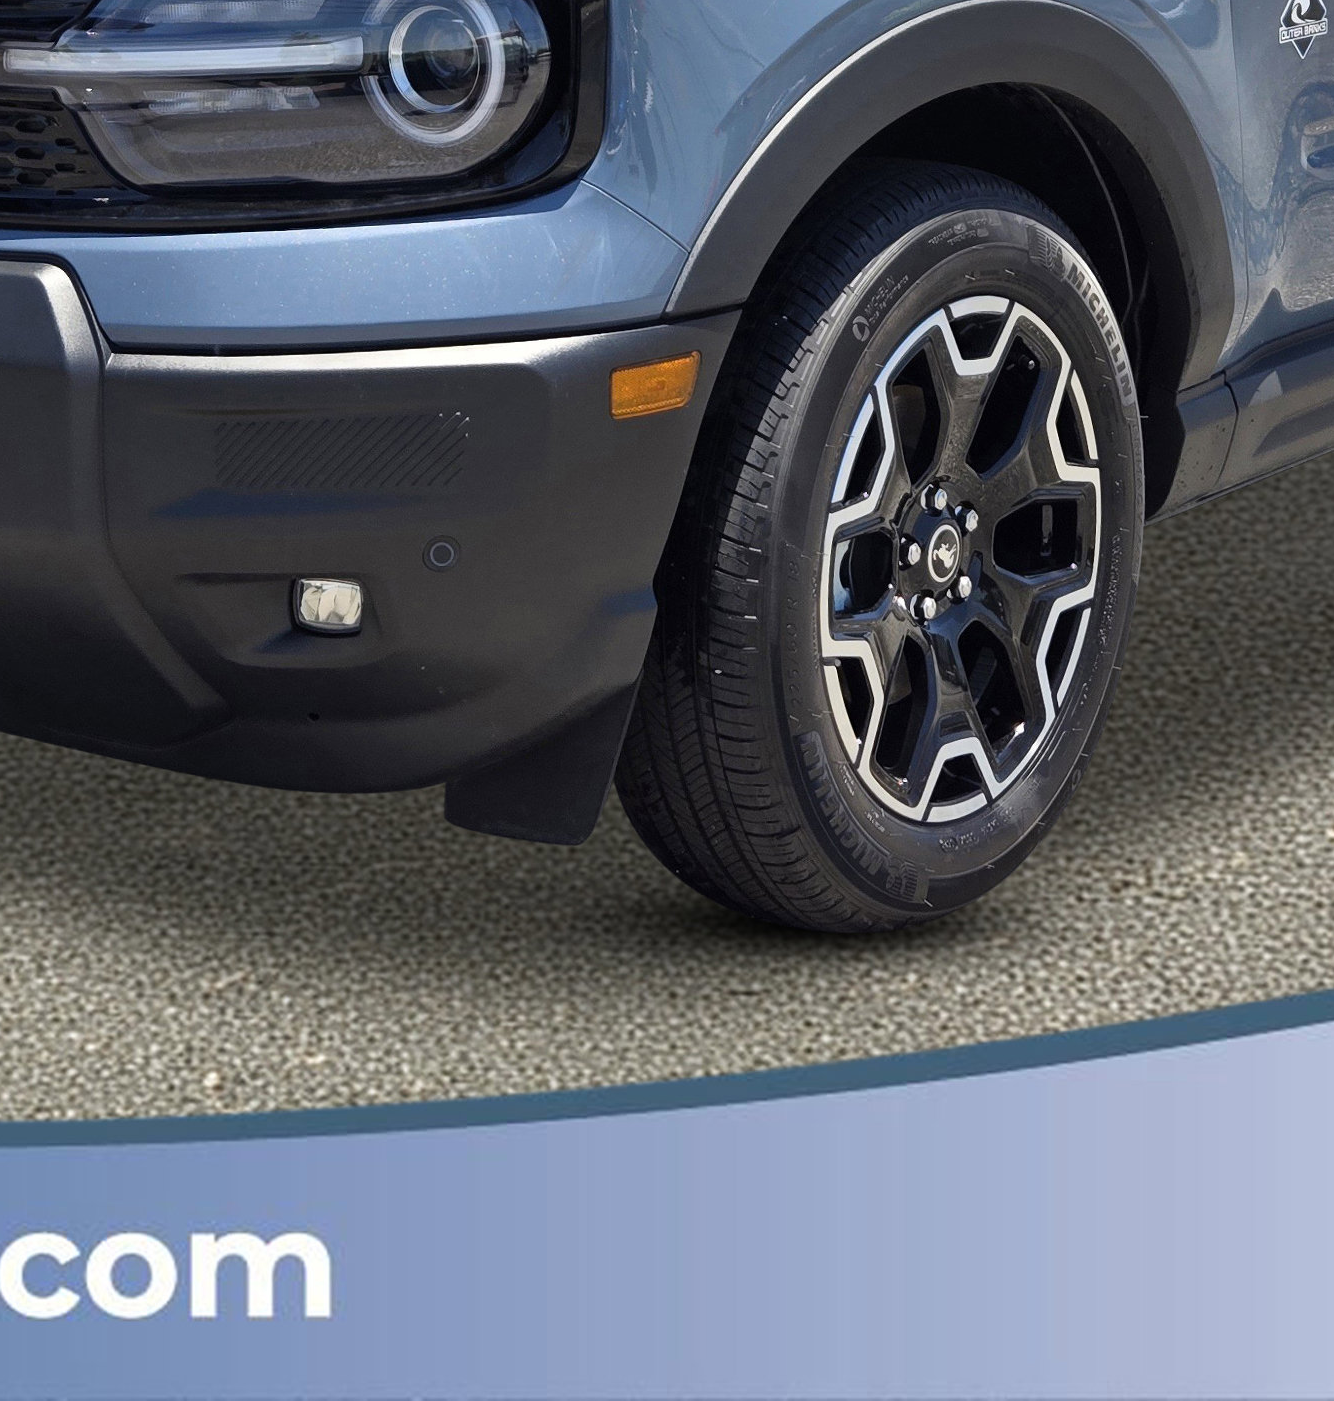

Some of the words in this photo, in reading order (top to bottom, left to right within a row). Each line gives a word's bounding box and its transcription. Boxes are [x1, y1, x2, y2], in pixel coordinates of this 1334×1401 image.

[1281, 27, 1303, 40] OUTER
[1304, 21, 1326, 36] BANKS
[1068, 262, 1133, 398] MICHELIN
[799, 736, 885, 876] MICHELIN
